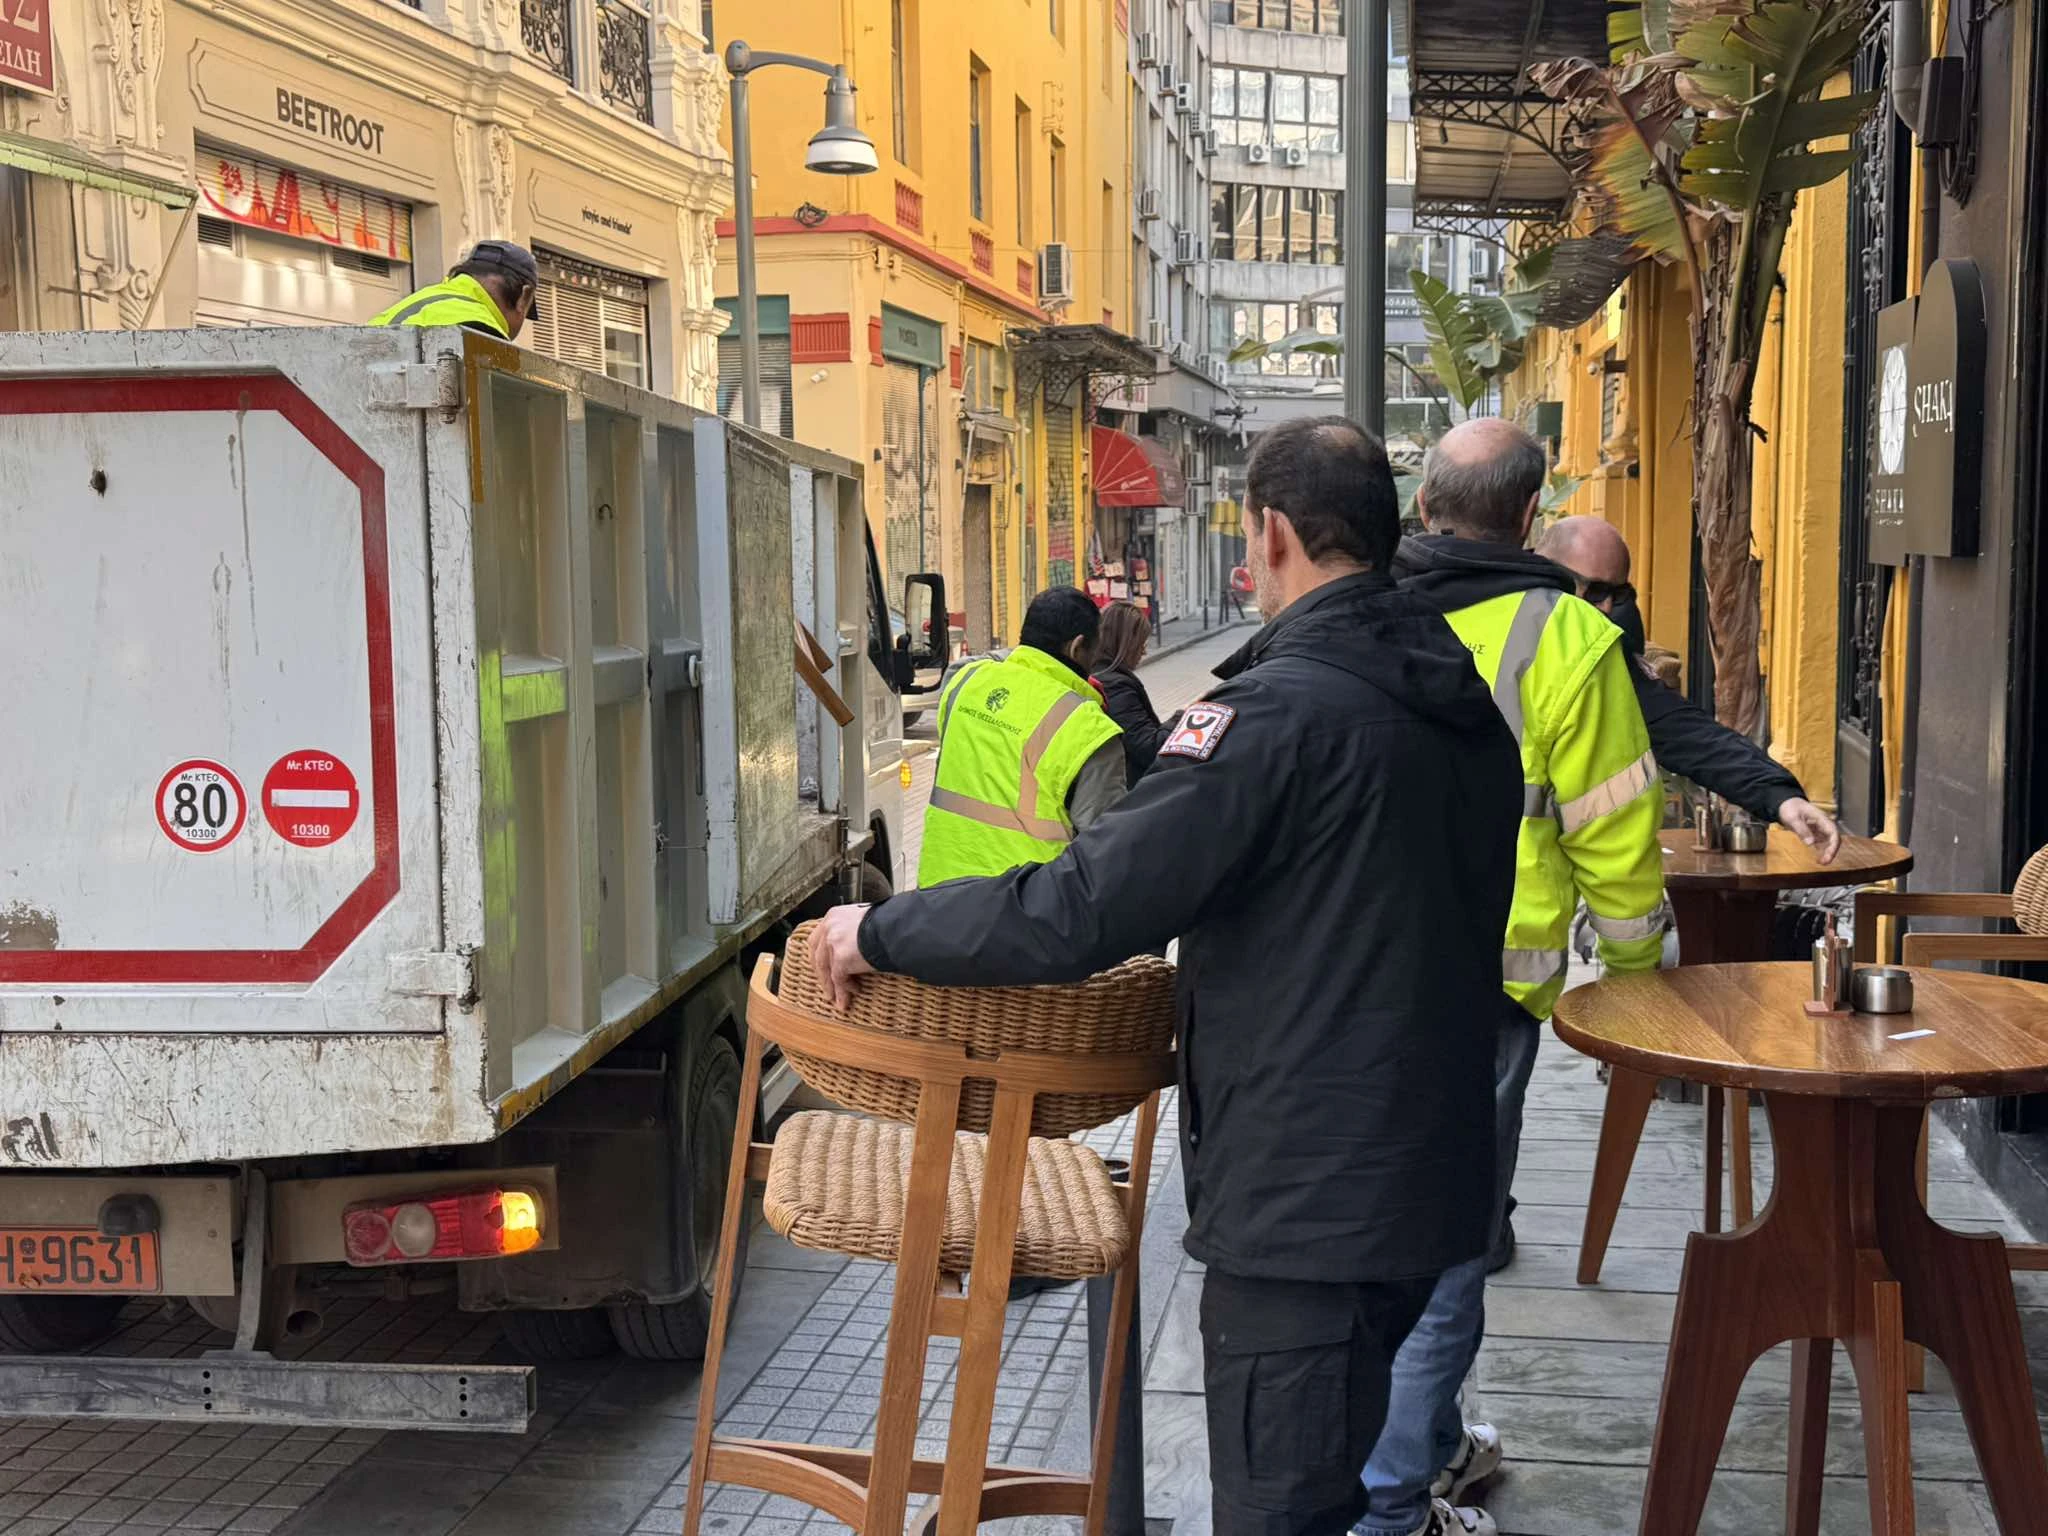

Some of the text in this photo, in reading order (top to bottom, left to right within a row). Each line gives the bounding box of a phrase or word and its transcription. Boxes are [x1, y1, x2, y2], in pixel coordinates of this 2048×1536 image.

[276, 87, 384, 154] BEETROOT
[304, 760, 334, 771] KTEO
[195, 773, 219, 782] KTEO
[174, 783, 227, 828] 80
[186, 829, 217, 838] 10300
[291, 824, 330, 836] 10300
